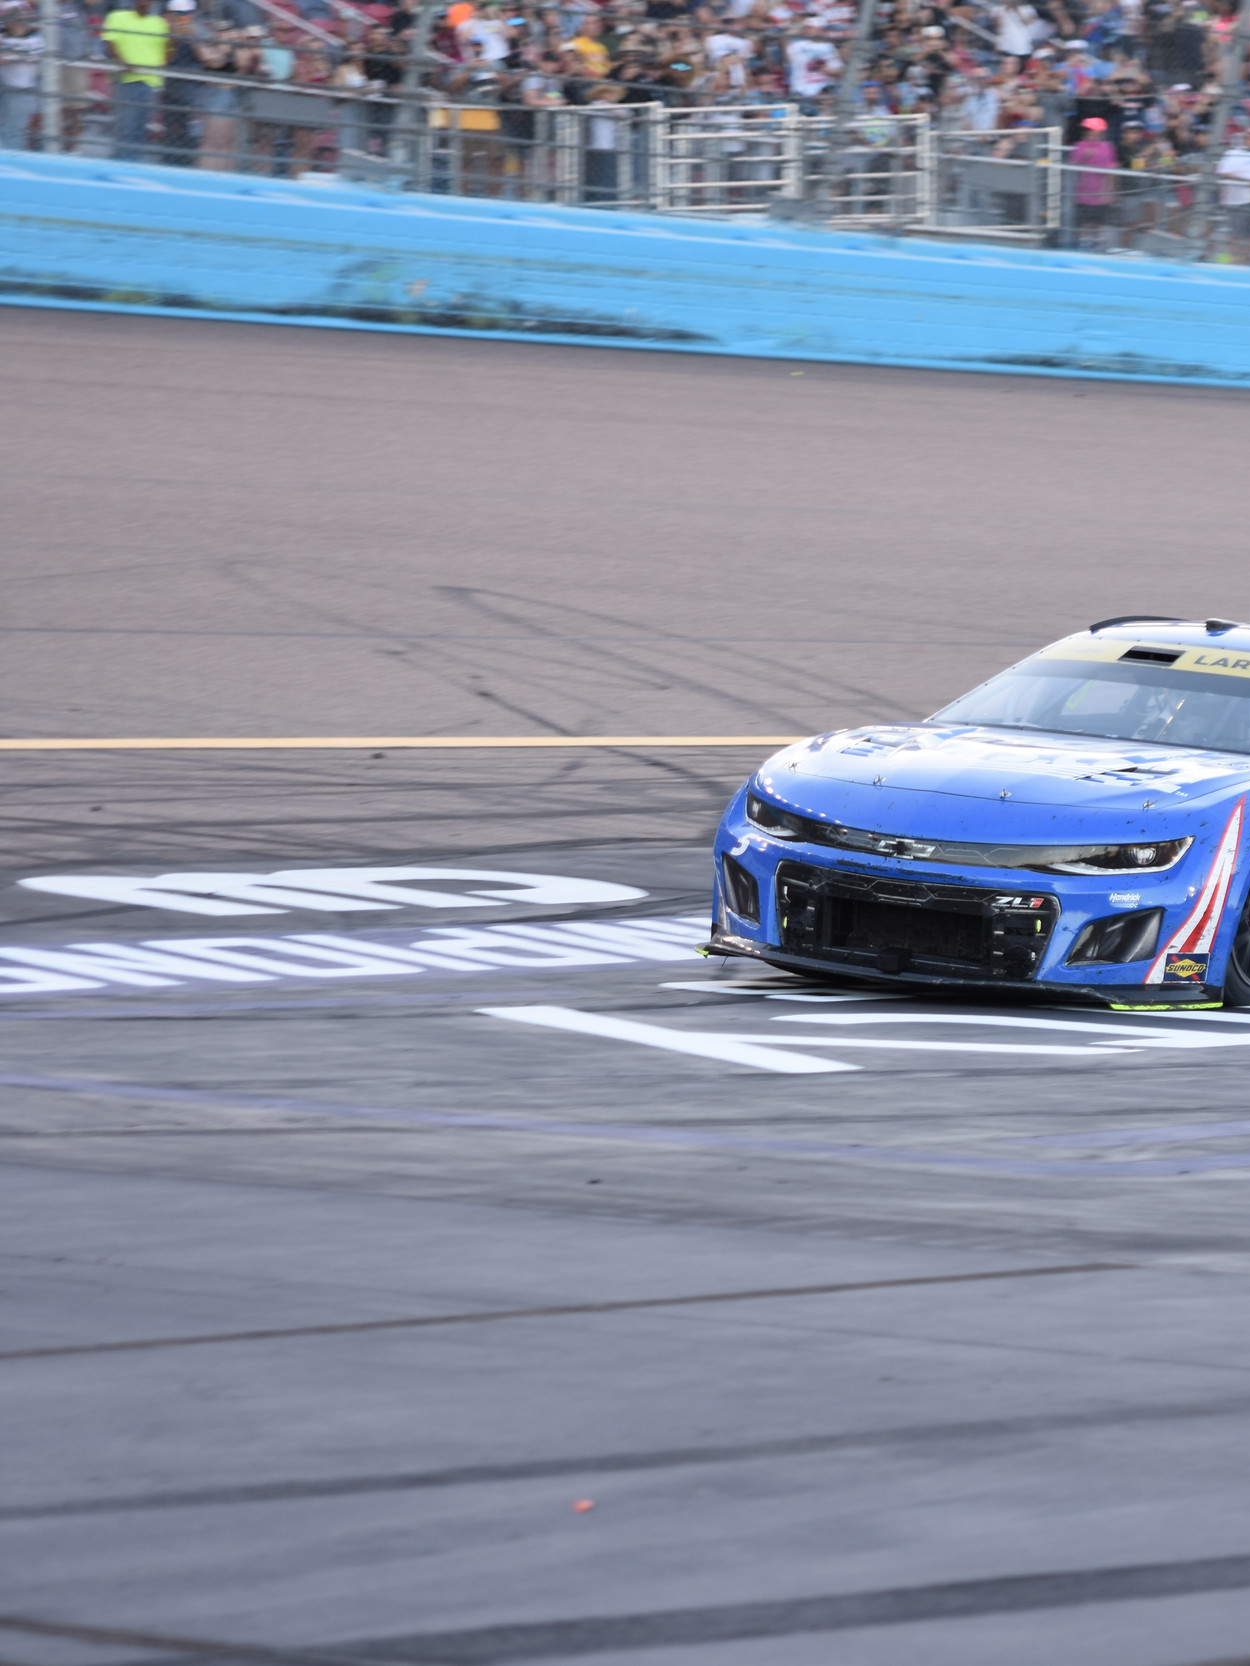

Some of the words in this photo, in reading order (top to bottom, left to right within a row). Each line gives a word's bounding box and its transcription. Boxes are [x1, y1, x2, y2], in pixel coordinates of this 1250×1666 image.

[730, 832, 761, 856] 5
[991, 896, 1045, 908] ZL1
[1109, 893, 1141, 903] Hendrick
[1167, 964, 1205, 972] SUNOCO
